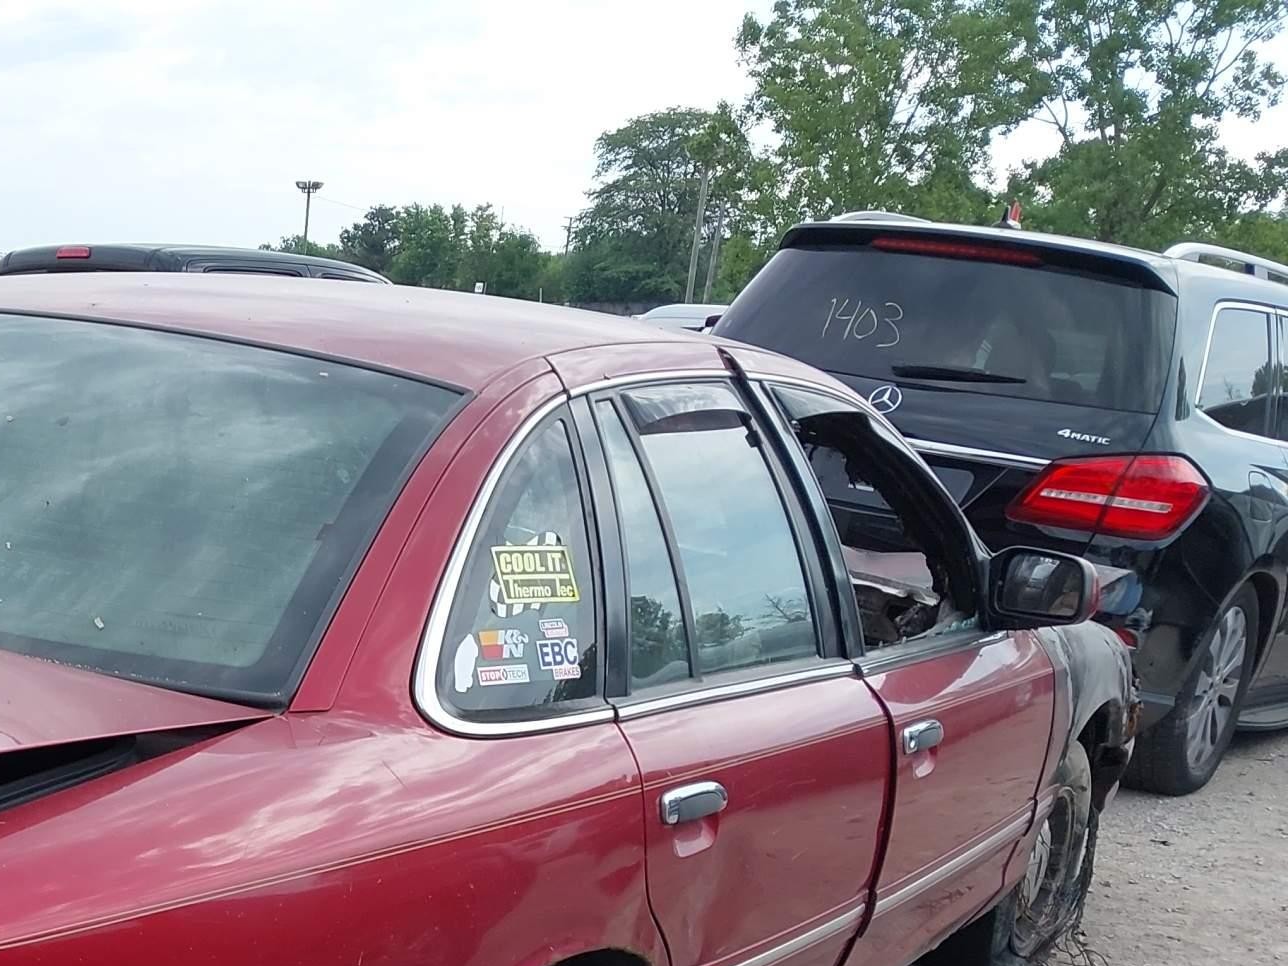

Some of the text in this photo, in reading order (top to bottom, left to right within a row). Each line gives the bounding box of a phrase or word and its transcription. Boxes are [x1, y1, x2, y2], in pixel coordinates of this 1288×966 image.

[822, 298, 903, 347] 1403
[1057, 429, 1111, 445] 4MATIC
[499, 552, 546, 573] COOL
[502, 574, 574, 598] Thermo Tec
[538, 641, 578, 667] EBC
[555, 666, 580, 678] BRAKES
